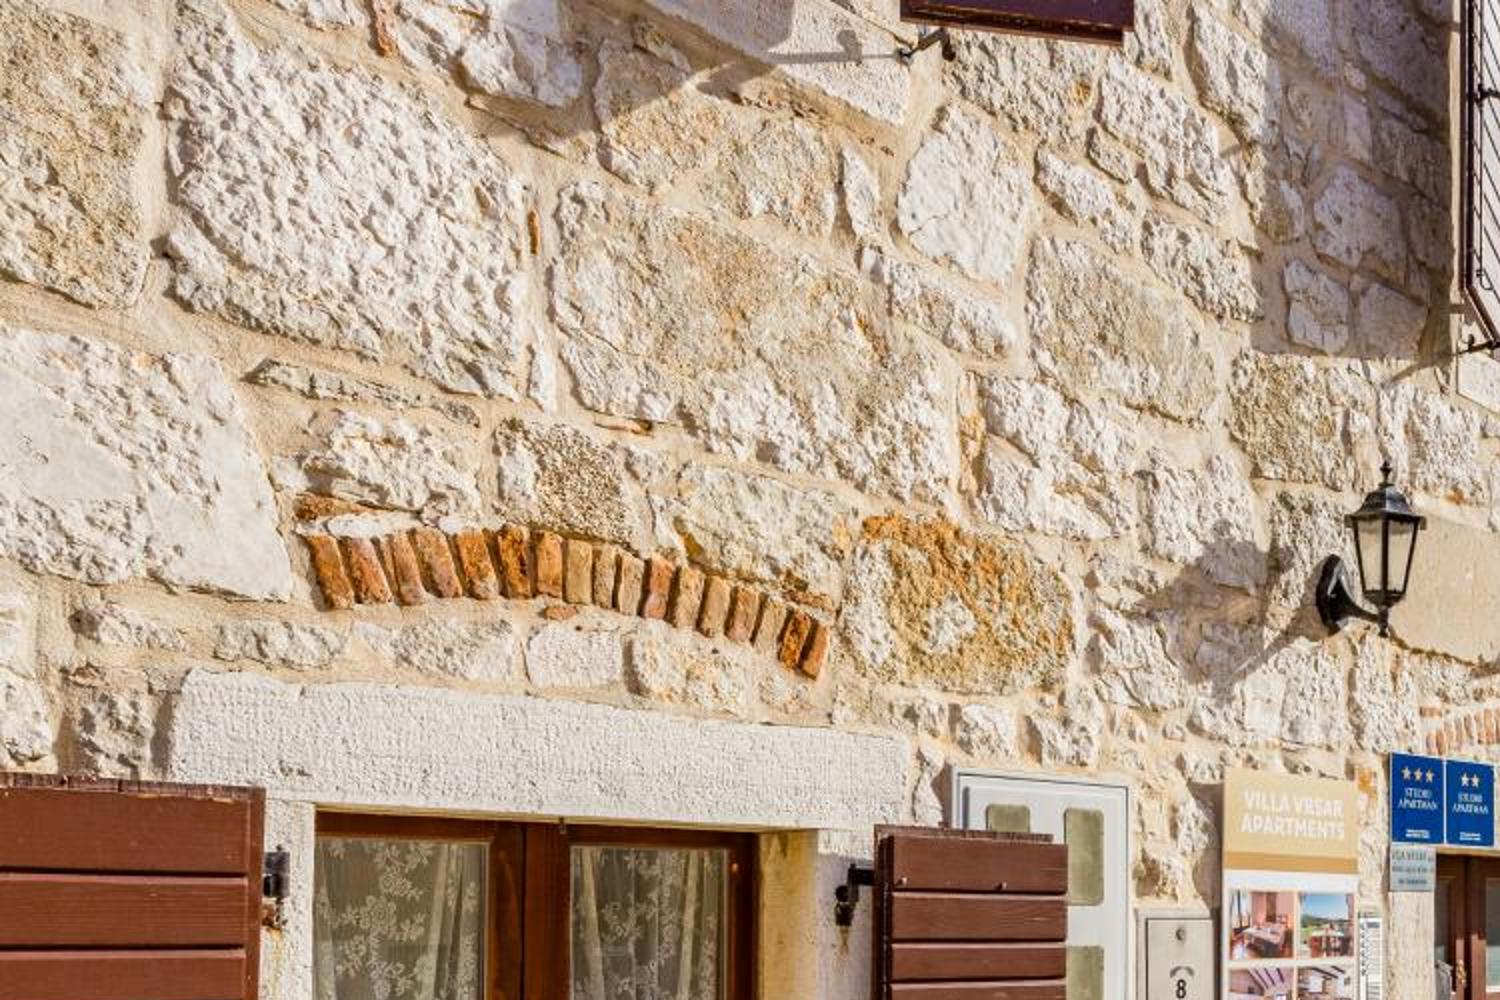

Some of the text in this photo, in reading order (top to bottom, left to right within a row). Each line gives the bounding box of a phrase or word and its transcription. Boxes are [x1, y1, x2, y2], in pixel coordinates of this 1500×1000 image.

[1243, 789, 1345, 817] VILLA VRSAR
[1240, 814, 1346, 839] APARTMENTS
[1175, 979, 1187, 1000] 8
